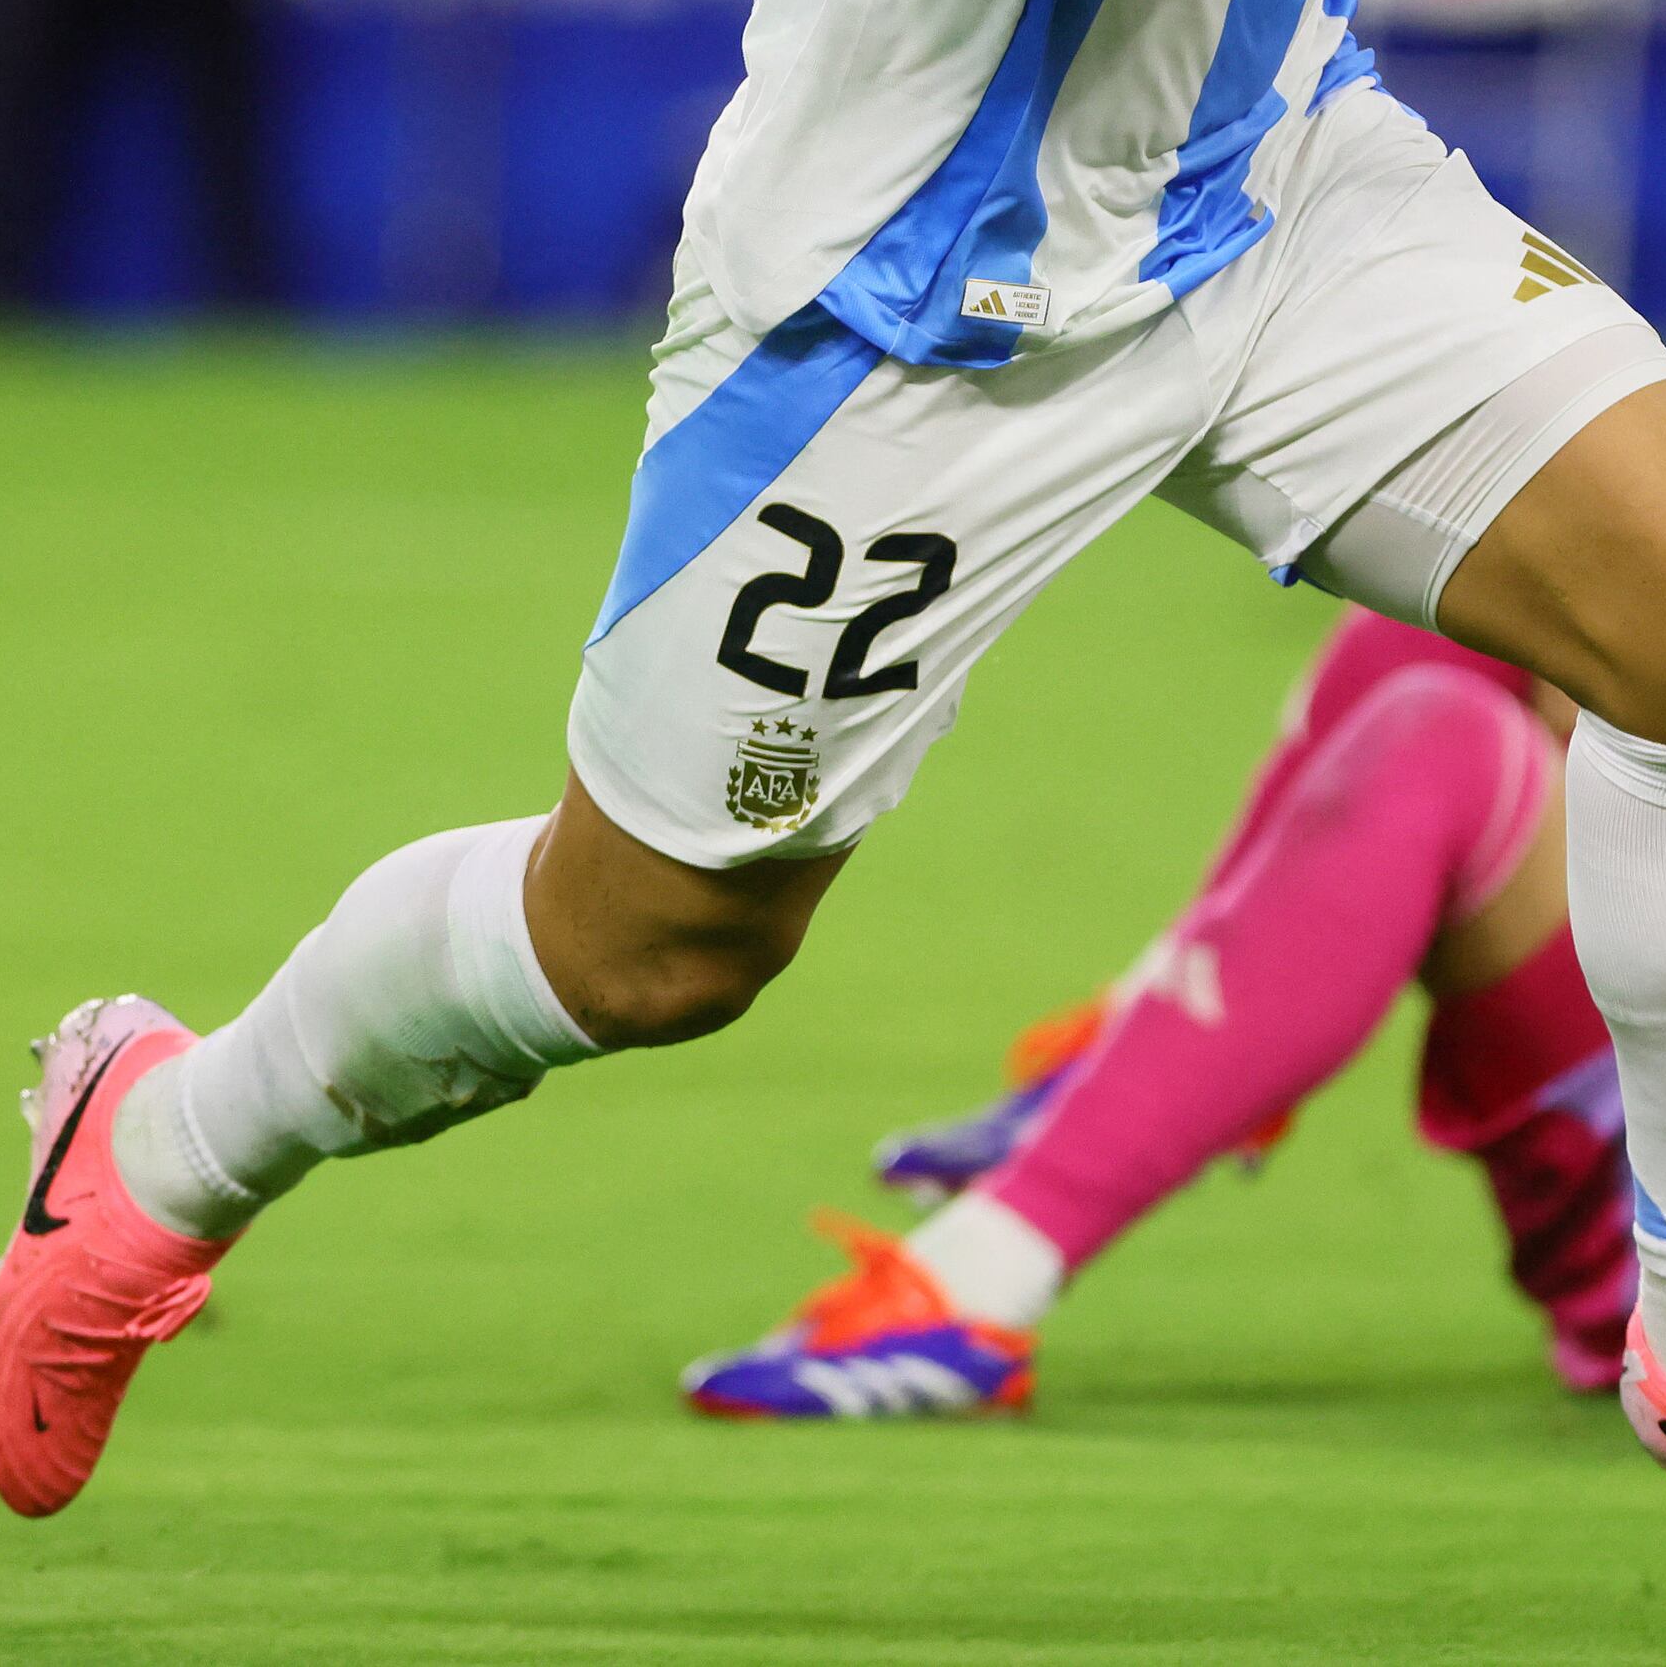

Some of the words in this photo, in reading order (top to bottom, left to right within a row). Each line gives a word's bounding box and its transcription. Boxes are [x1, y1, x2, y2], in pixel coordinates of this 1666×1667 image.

[1012, 291, 1042, 301] AUTHENTIC
[1014, 310, 1039, 318] PRODUCT
[717, 501, 958, 700] 22
[744, 765, 799, 808] AFA
